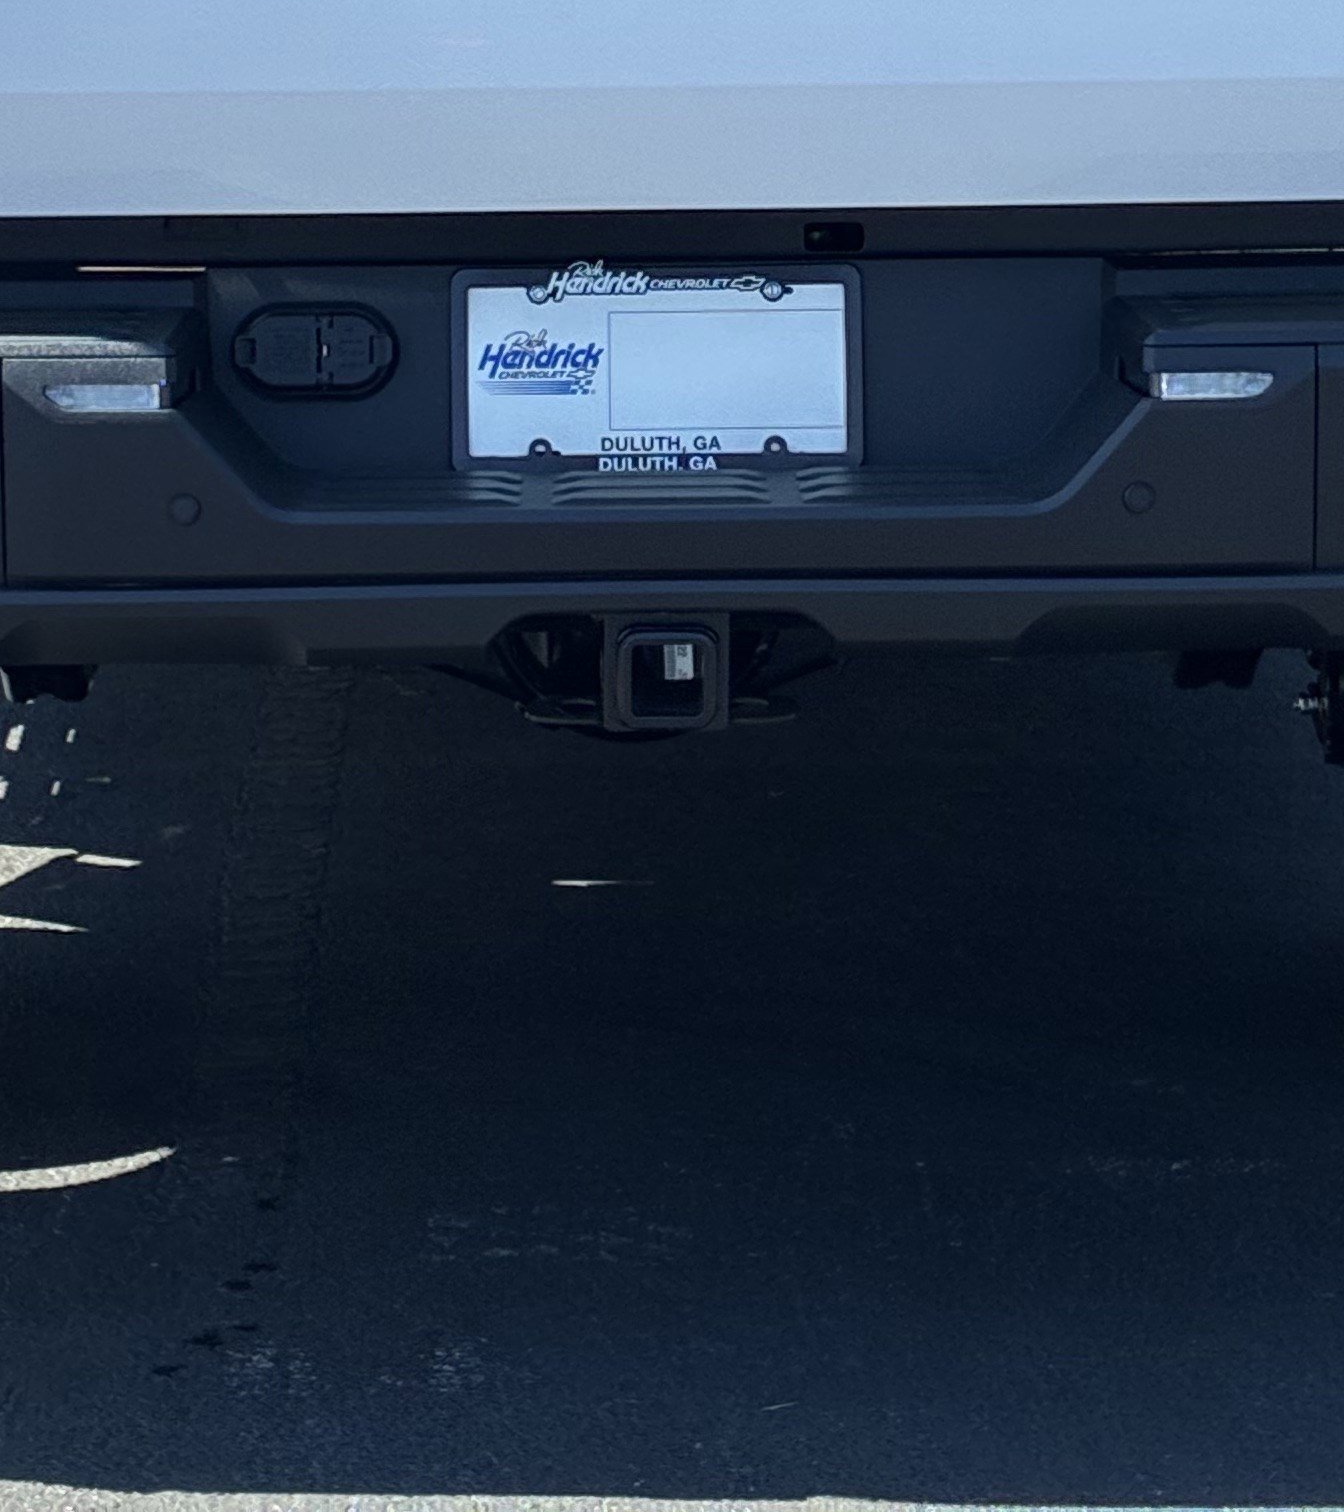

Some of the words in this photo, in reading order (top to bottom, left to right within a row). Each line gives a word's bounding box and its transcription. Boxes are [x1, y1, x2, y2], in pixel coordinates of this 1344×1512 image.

[547, 271, 649, 302] Hendrick
[649, 278, 729, 289] CHEVROLET
[478, 342, 605, 379] Hendrick
[498, 370, 567, 380] CHEVROLET
[601, 436, 686, 454] DULUTH,
[693, 435, 721, 451] GA
[689, 456, 717, 471] GA
